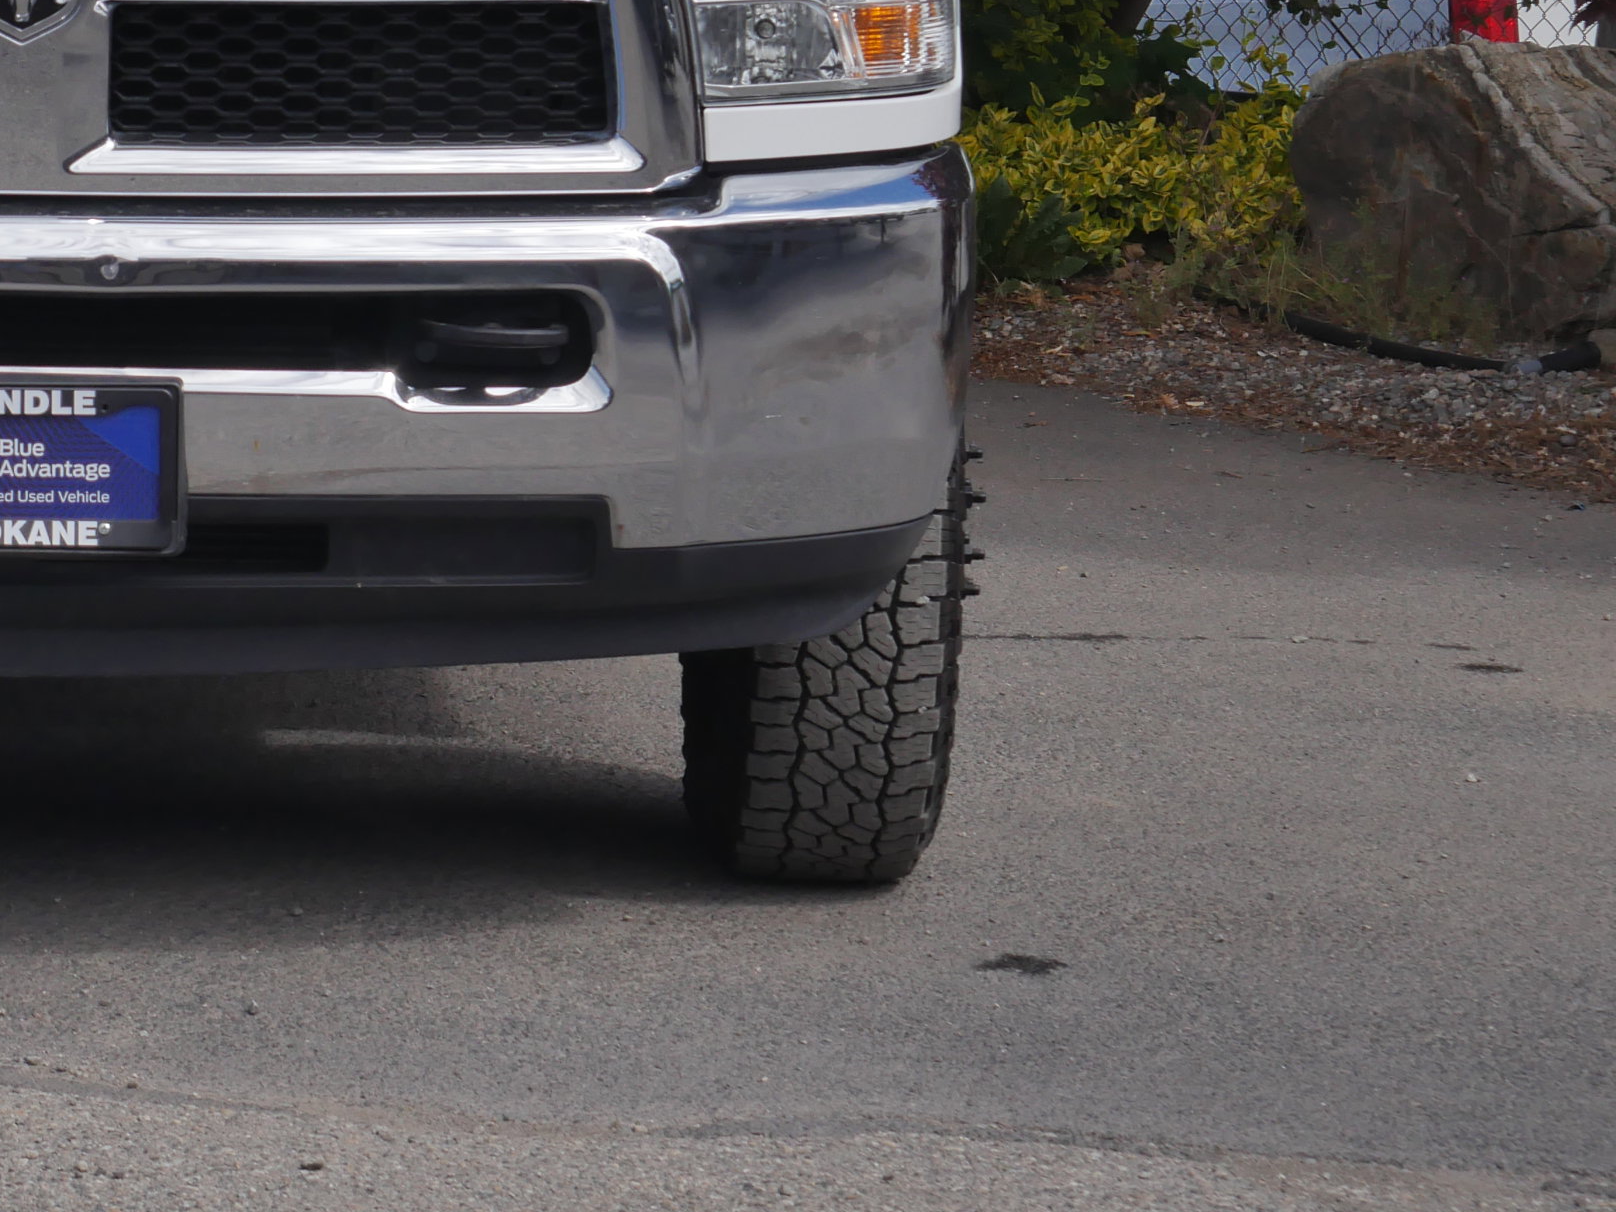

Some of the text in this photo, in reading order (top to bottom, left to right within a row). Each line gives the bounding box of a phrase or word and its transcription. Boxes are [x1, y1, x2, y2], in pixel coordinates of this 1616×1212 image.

[0, 438, 45, 457] Blue
[17, 490, 54, 504] Used
[58, 490, 110, 504] Vehicle
